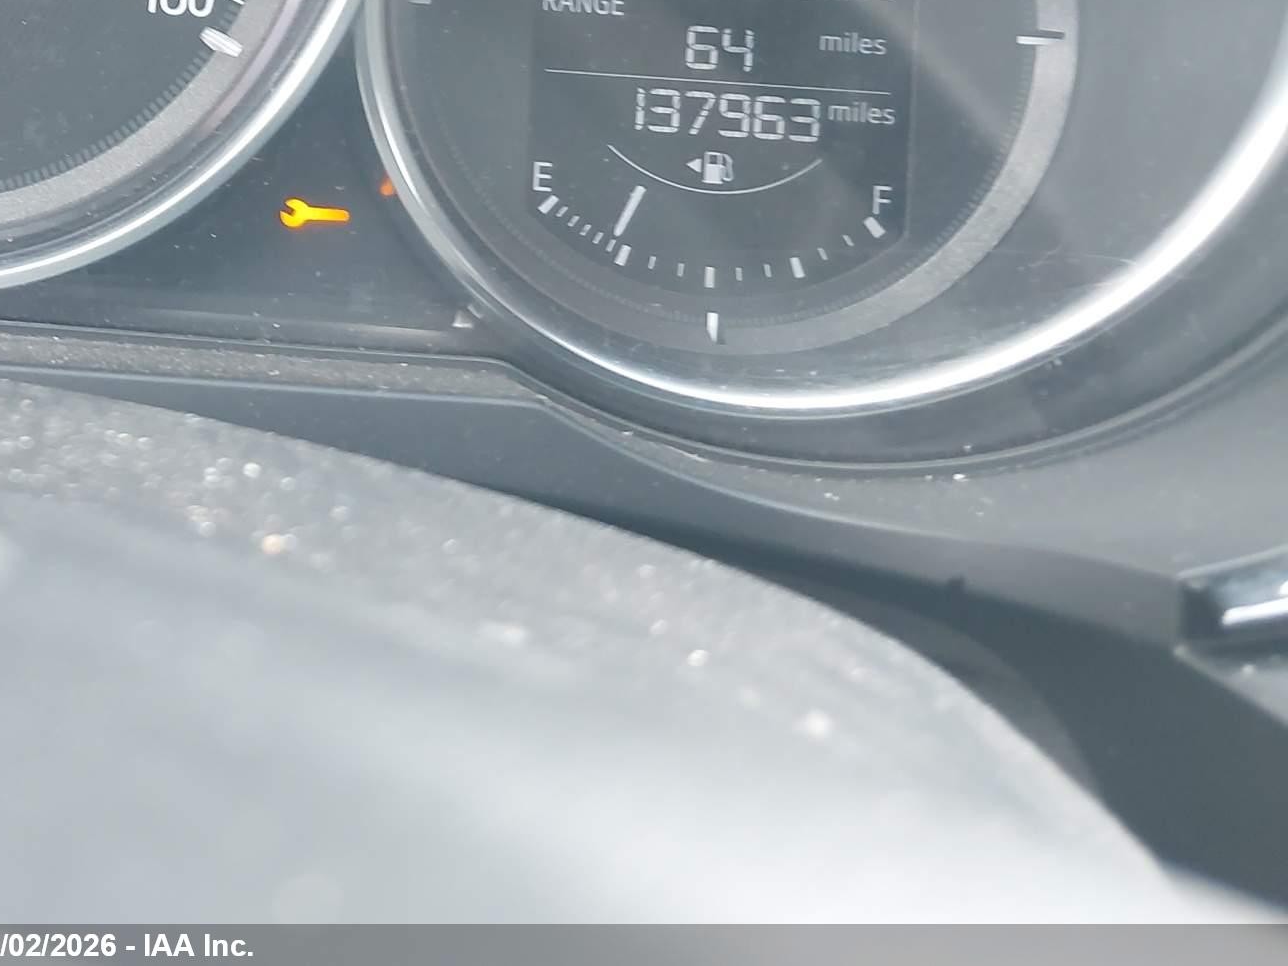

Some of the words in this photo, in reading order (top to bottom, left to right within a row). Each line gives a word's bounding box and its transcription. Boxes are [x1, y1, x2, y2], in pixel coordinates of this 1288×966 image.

[685, 24, 755, 72] 64
[819, 33, 887, 55] miles
[634, 87, 822, 143] 137963
[827, 102, 896, 126] miles
[533, 161, 553, 191] E
[873, 186, 892, 215] F
